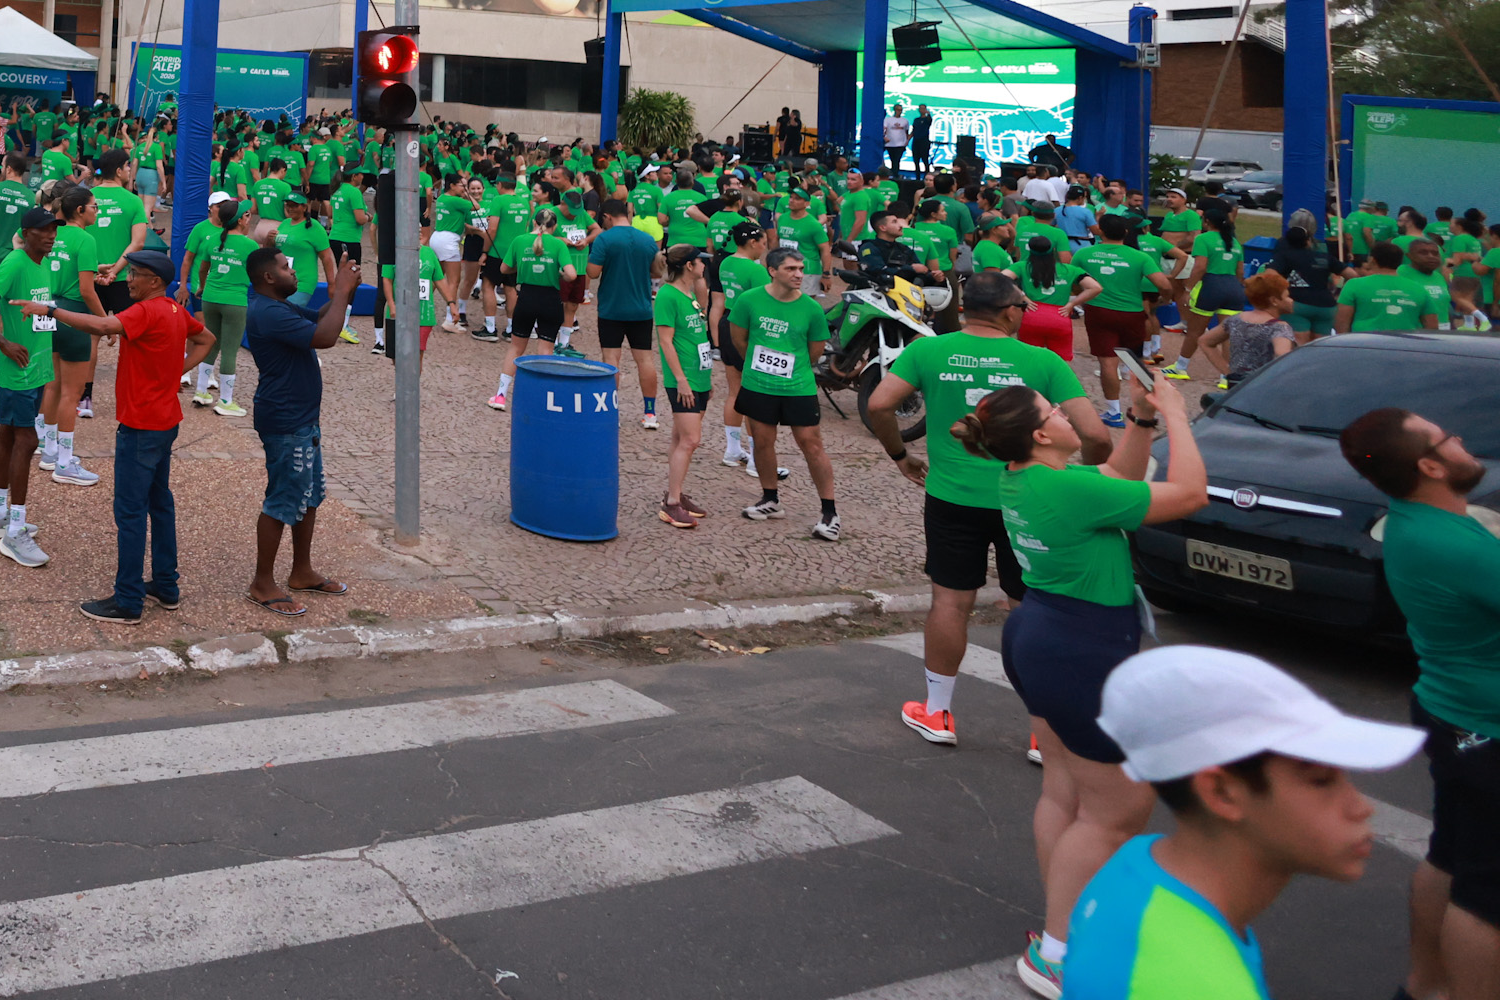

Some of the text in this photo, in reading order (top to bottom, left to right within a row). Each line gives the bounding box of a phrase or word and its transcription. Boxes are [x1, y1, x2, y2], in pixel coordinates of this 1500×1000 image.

[160, 72, 175, 80] 2026
[1367, 116, 1395, 124] ALEPI
[759, 316, 789, 327] CORRIDA
[760, 322, 788, 334] ALEPI
[758, 353, 788, 369] 5529
[939, 373, 1026, 386] CAIXA BRASIL
